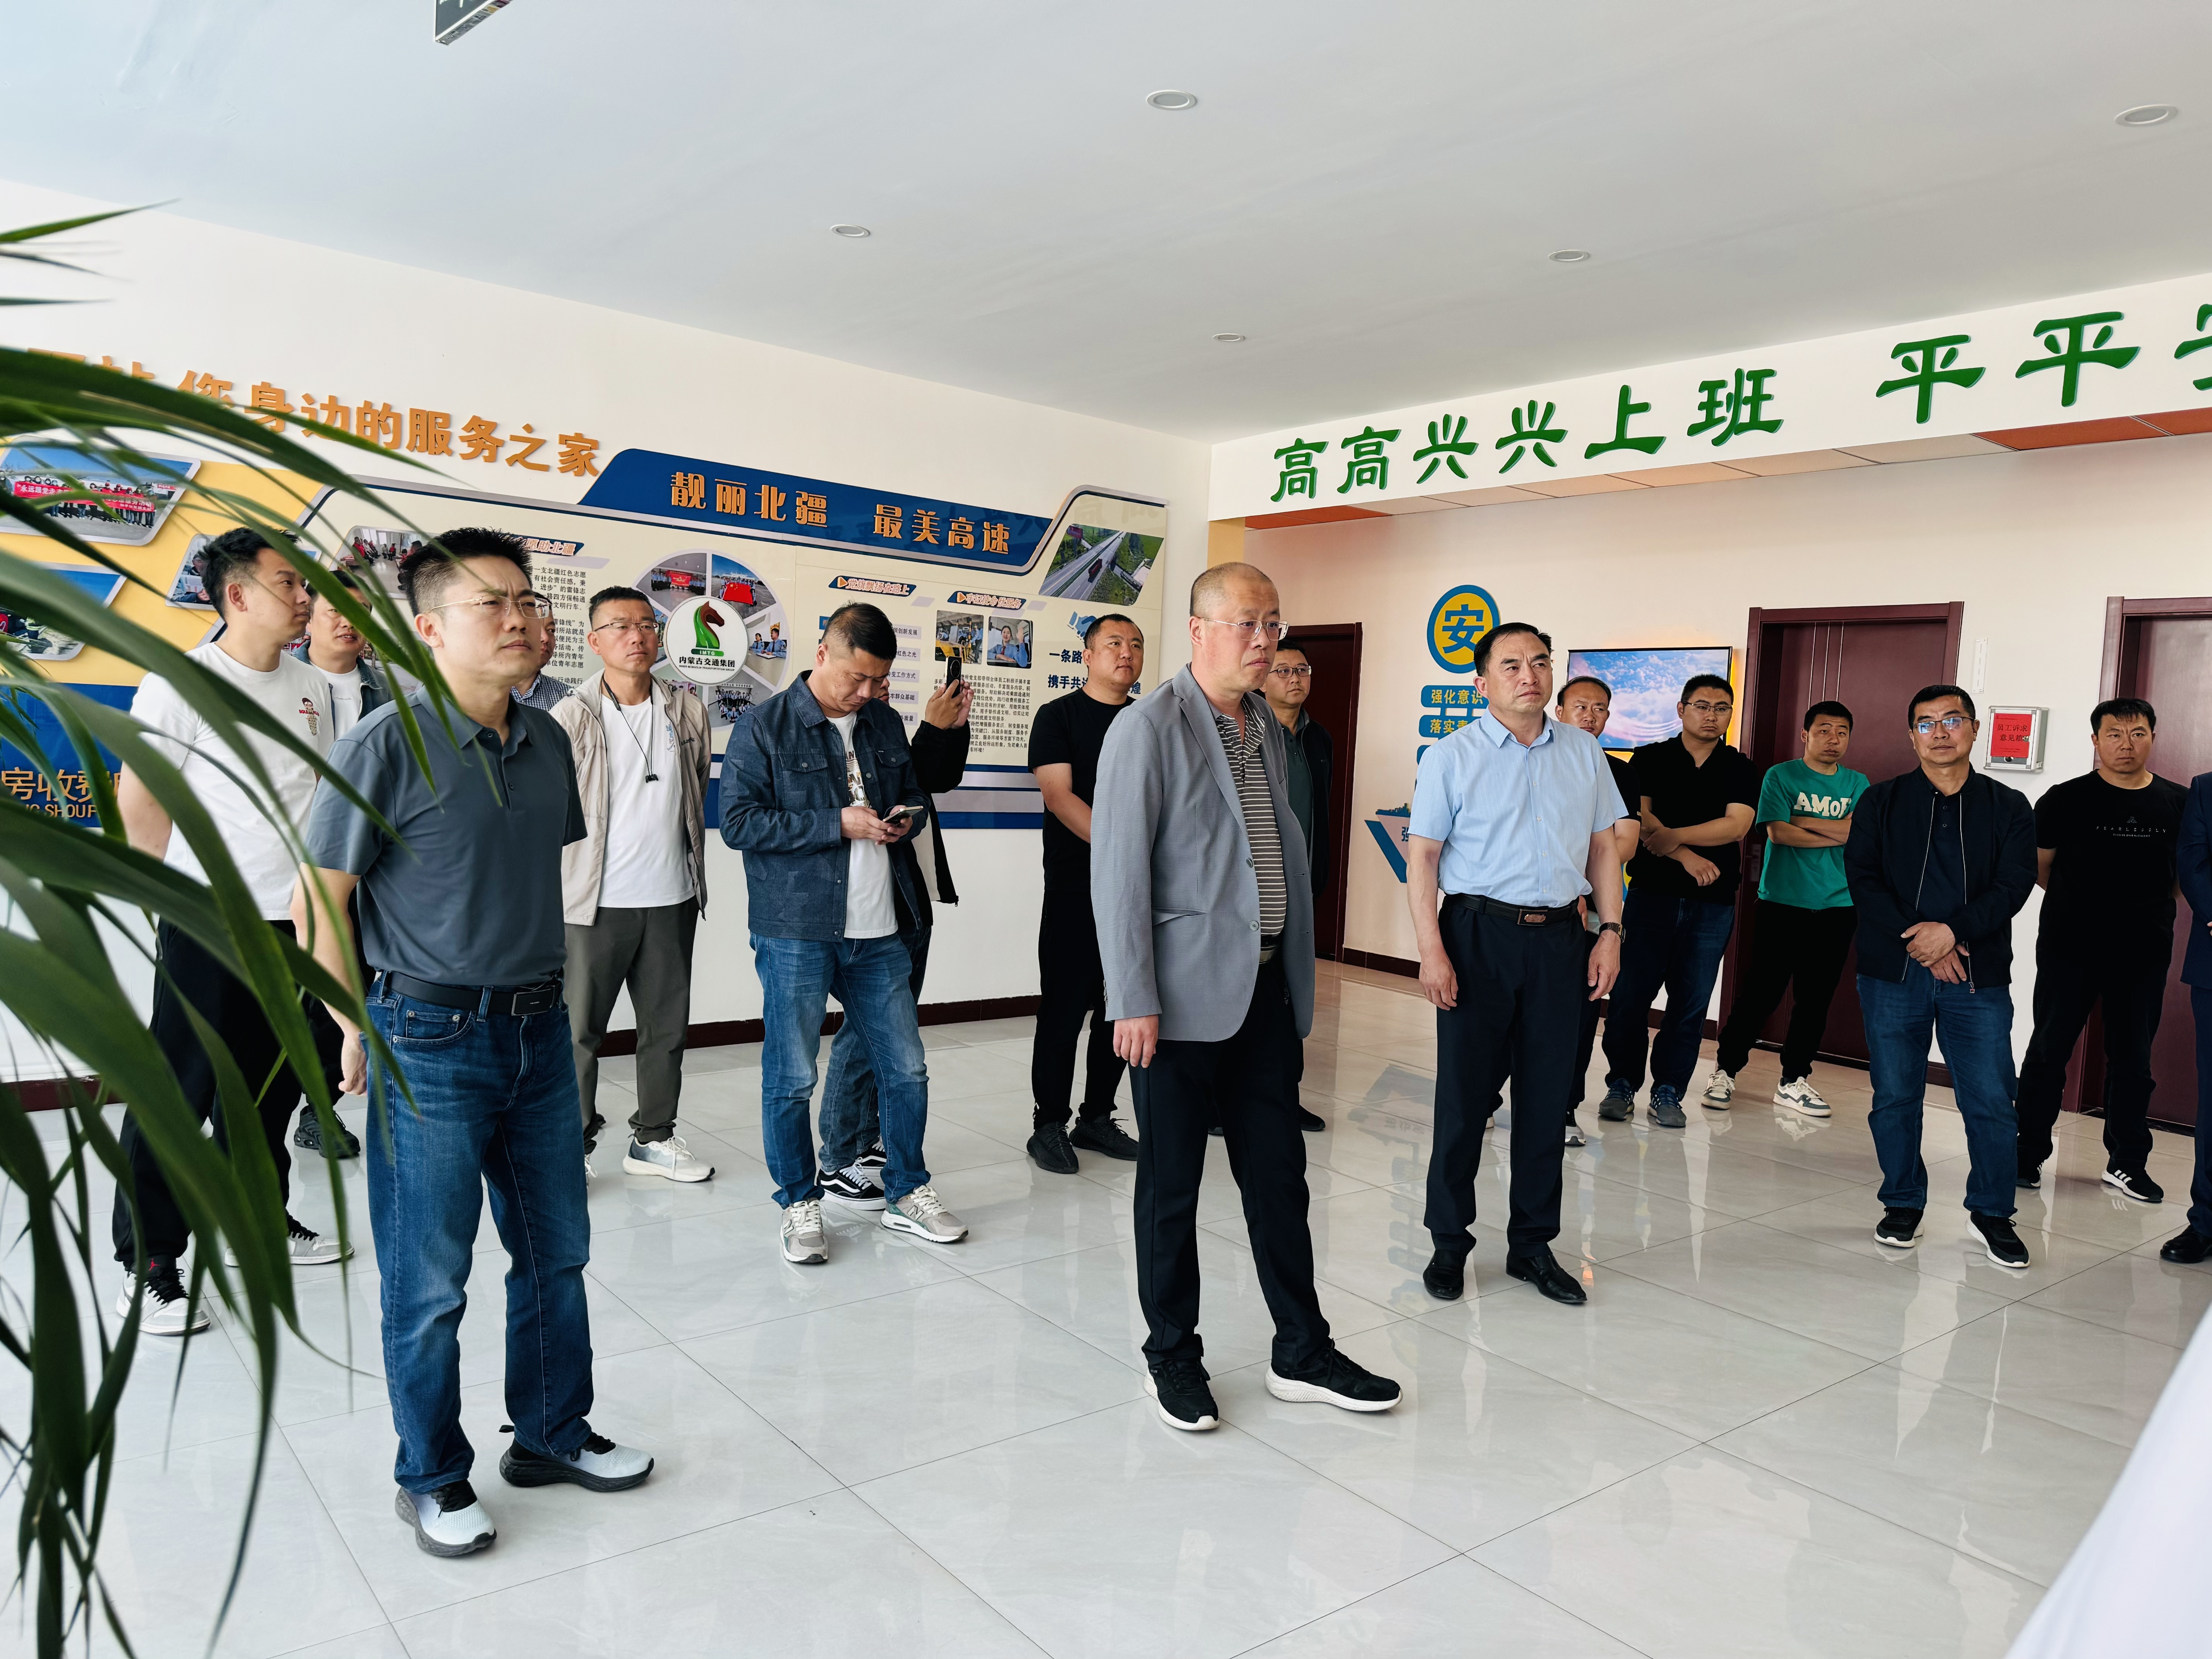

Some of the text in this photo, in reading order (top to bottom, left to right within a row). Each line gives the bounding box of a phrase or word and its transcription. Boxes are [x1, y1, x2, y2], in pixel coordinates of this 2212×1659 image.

[1271, 368, 1784, 502] 高高兴兴上班
[671, 471, 1010, 555] 靓丽北疆 最美高速
[846, 578, 910, 595] 党旗飘扬在路上
[966, 593, 1022, 609] 牢记使命优服务
[1442, 604, 1484, 654] 安
[679, 656, 735, 668] 内蒙古交通集团
[1049, 649, 1082, 664] 一条路
[552, 676, 583, 685] 行动践行
[1431, 689, 1483, 704] 强化意识
[1430, 718, 1477, 734] 落实责
[2, 766, 121, 803] 房收费
